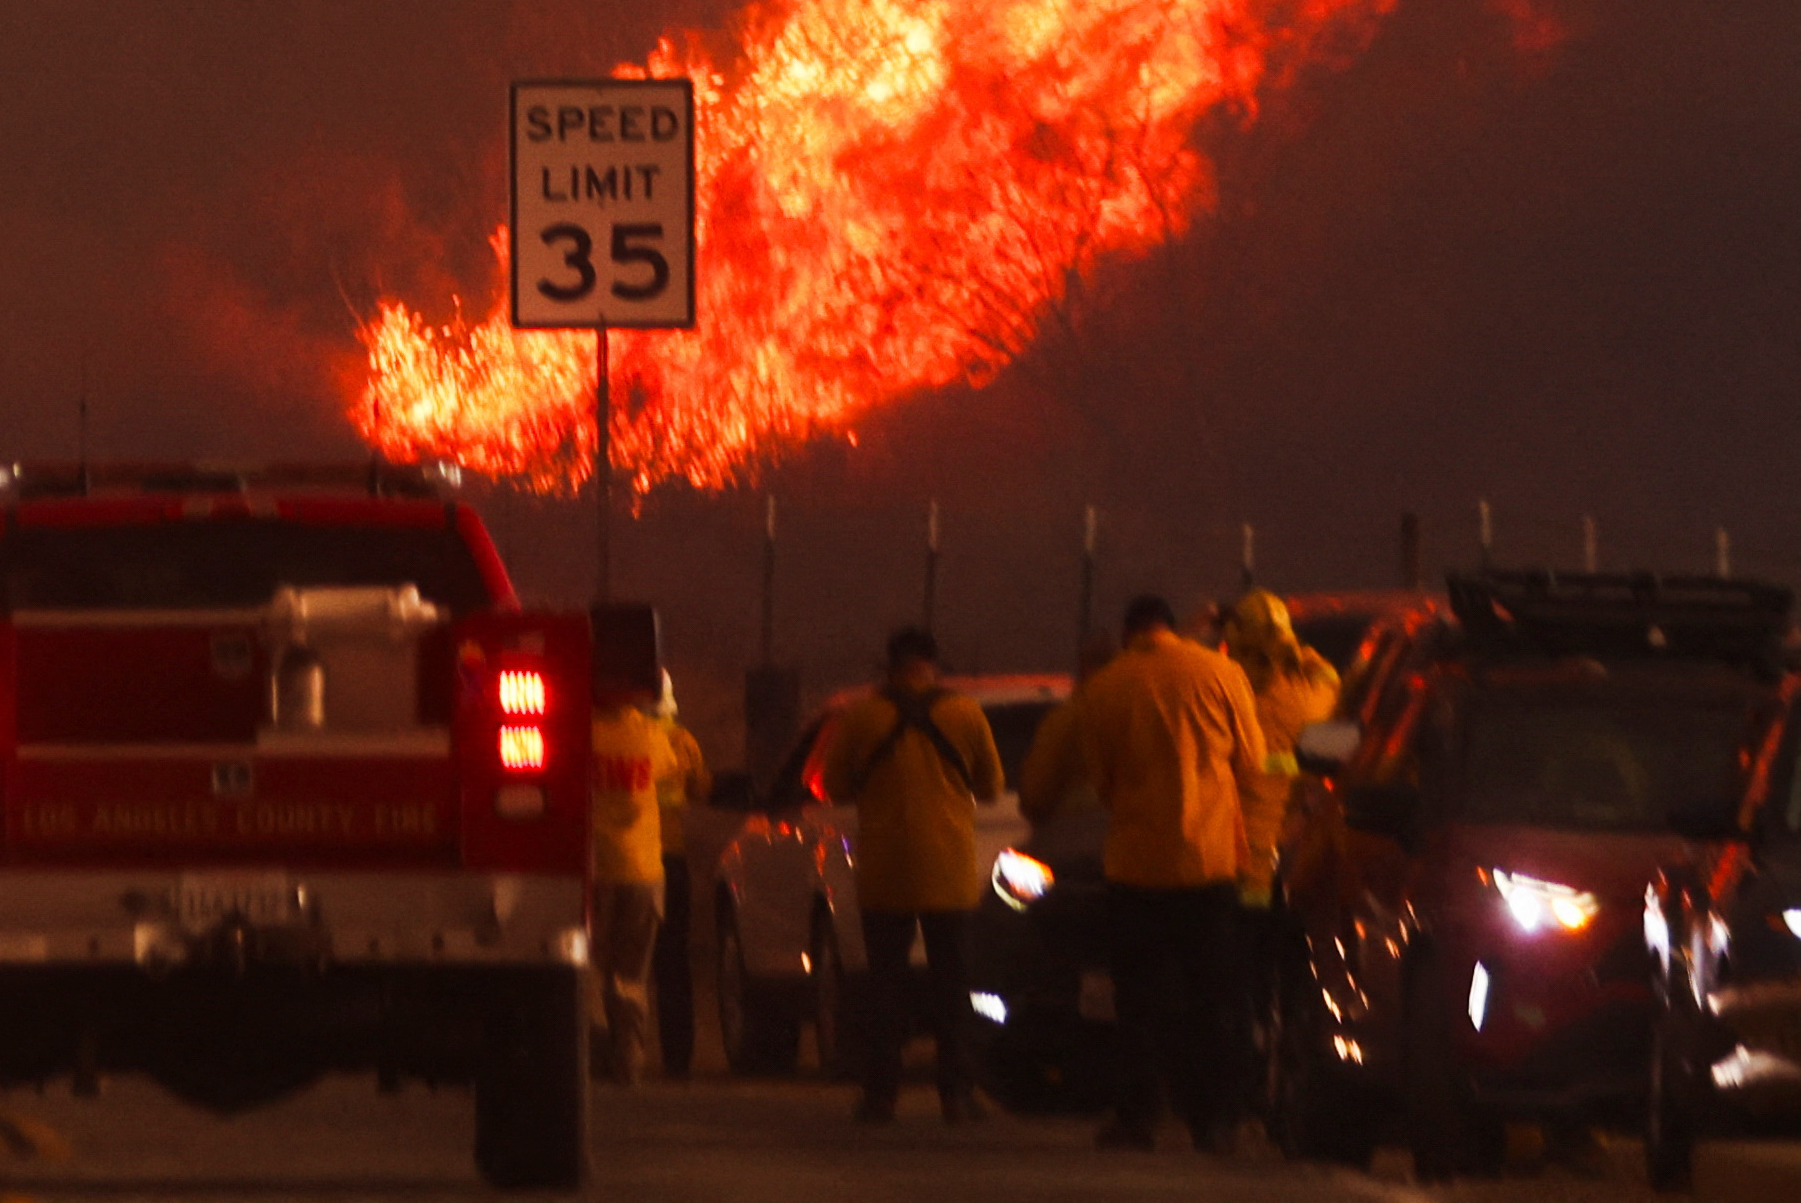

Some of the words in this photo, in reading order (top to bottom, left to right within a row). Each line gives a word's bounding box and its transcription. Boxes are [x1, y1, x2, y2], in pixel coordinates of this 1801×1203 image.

[527, 105, 678, 143] SPEED
[542, 165, 660, 202] LIMIT
[537, 222, 670, 303] 35
[92, 801, 217, 835] ANGELES
[236, 801, 354, 835] COUNTY
